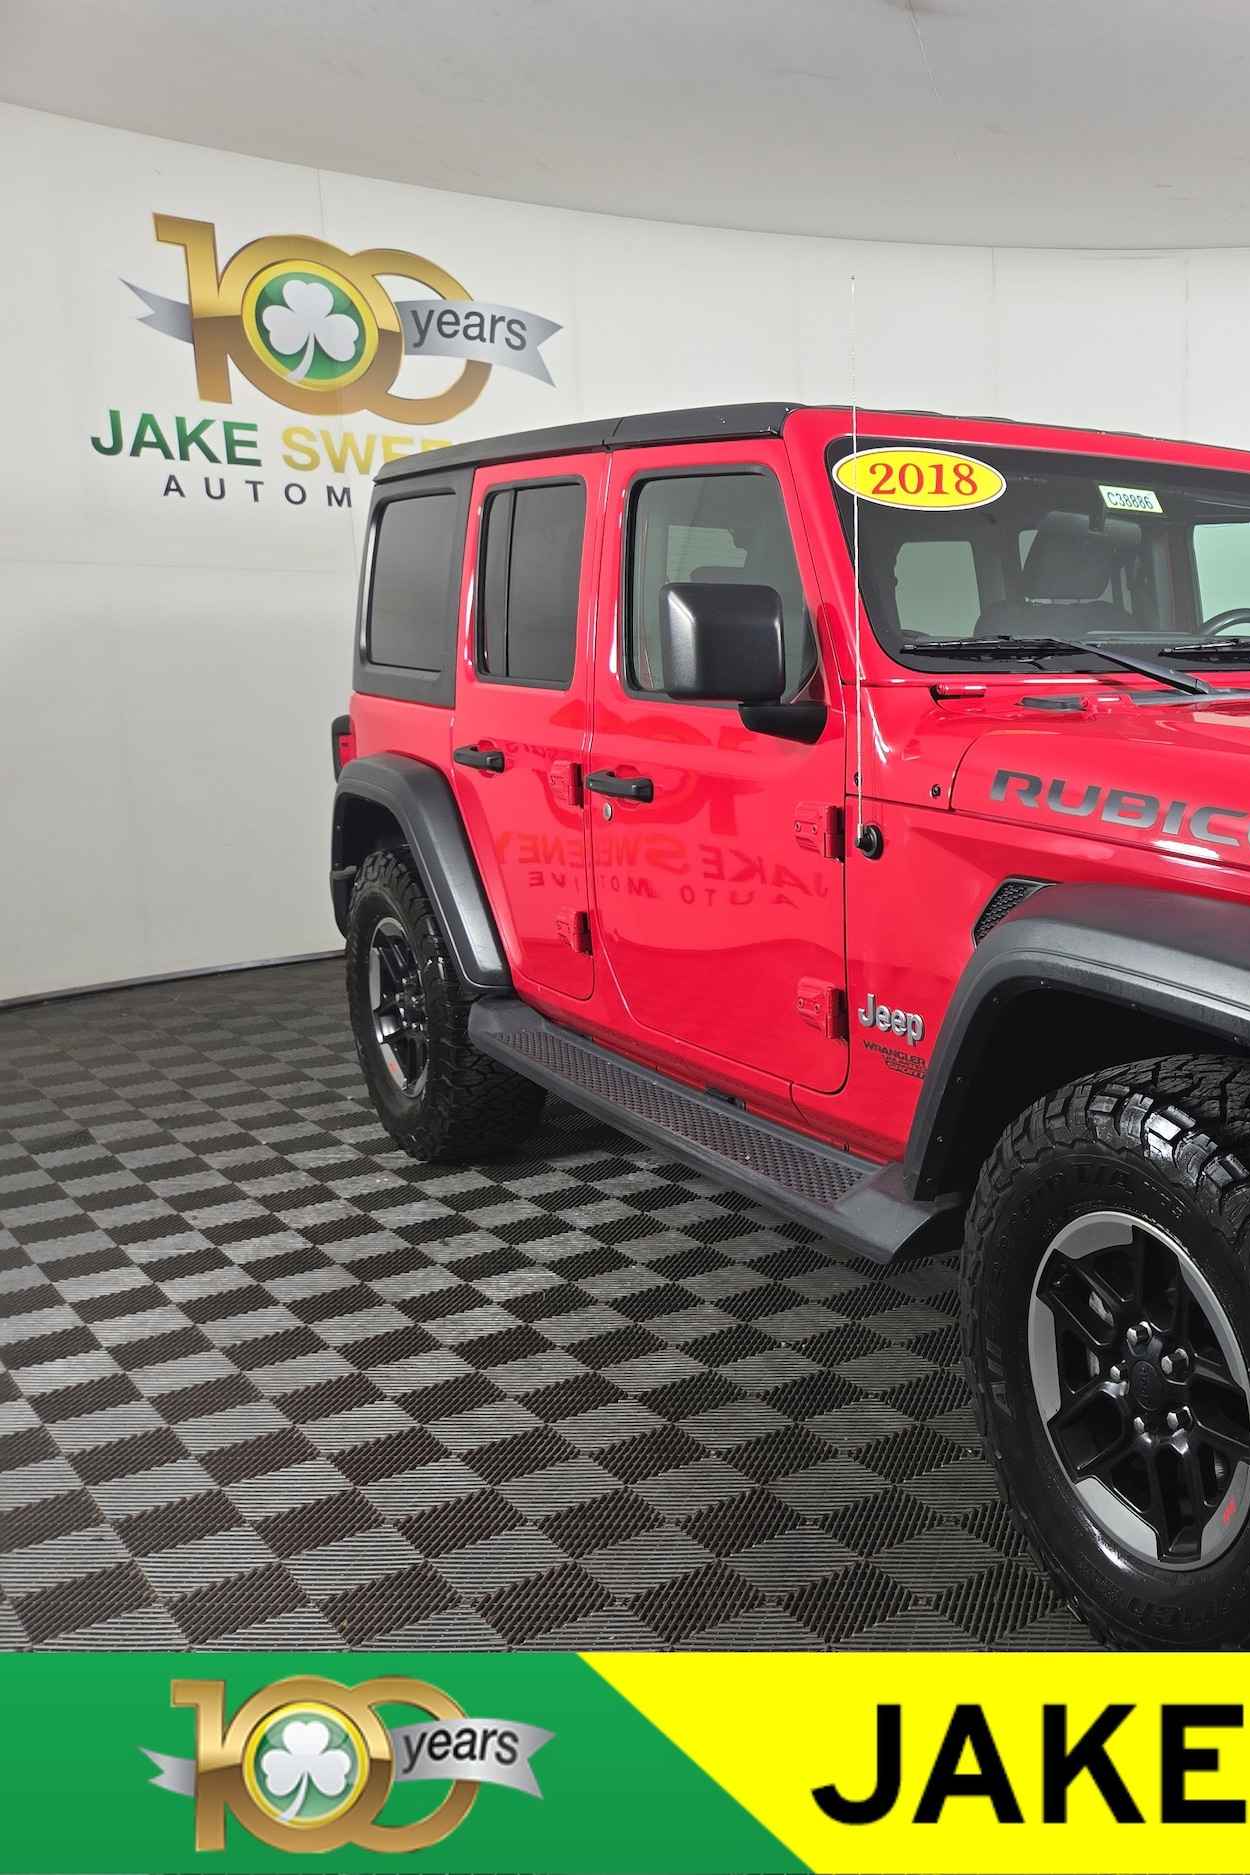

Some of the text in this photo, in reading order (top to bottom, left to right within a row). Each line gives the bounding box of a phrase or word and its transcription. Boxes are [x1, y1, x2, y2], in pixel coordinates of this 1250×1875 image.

[152, 212, 528, 425] 100 years
[90, 408, 262, 468] JAKE
[869, 463, 979, 496] 2018
[1106, 491, 1154, 510] C38886
[858, 993, 925, 1047] Jeep
[862, 1039, 927, 1068] WRANGLER
